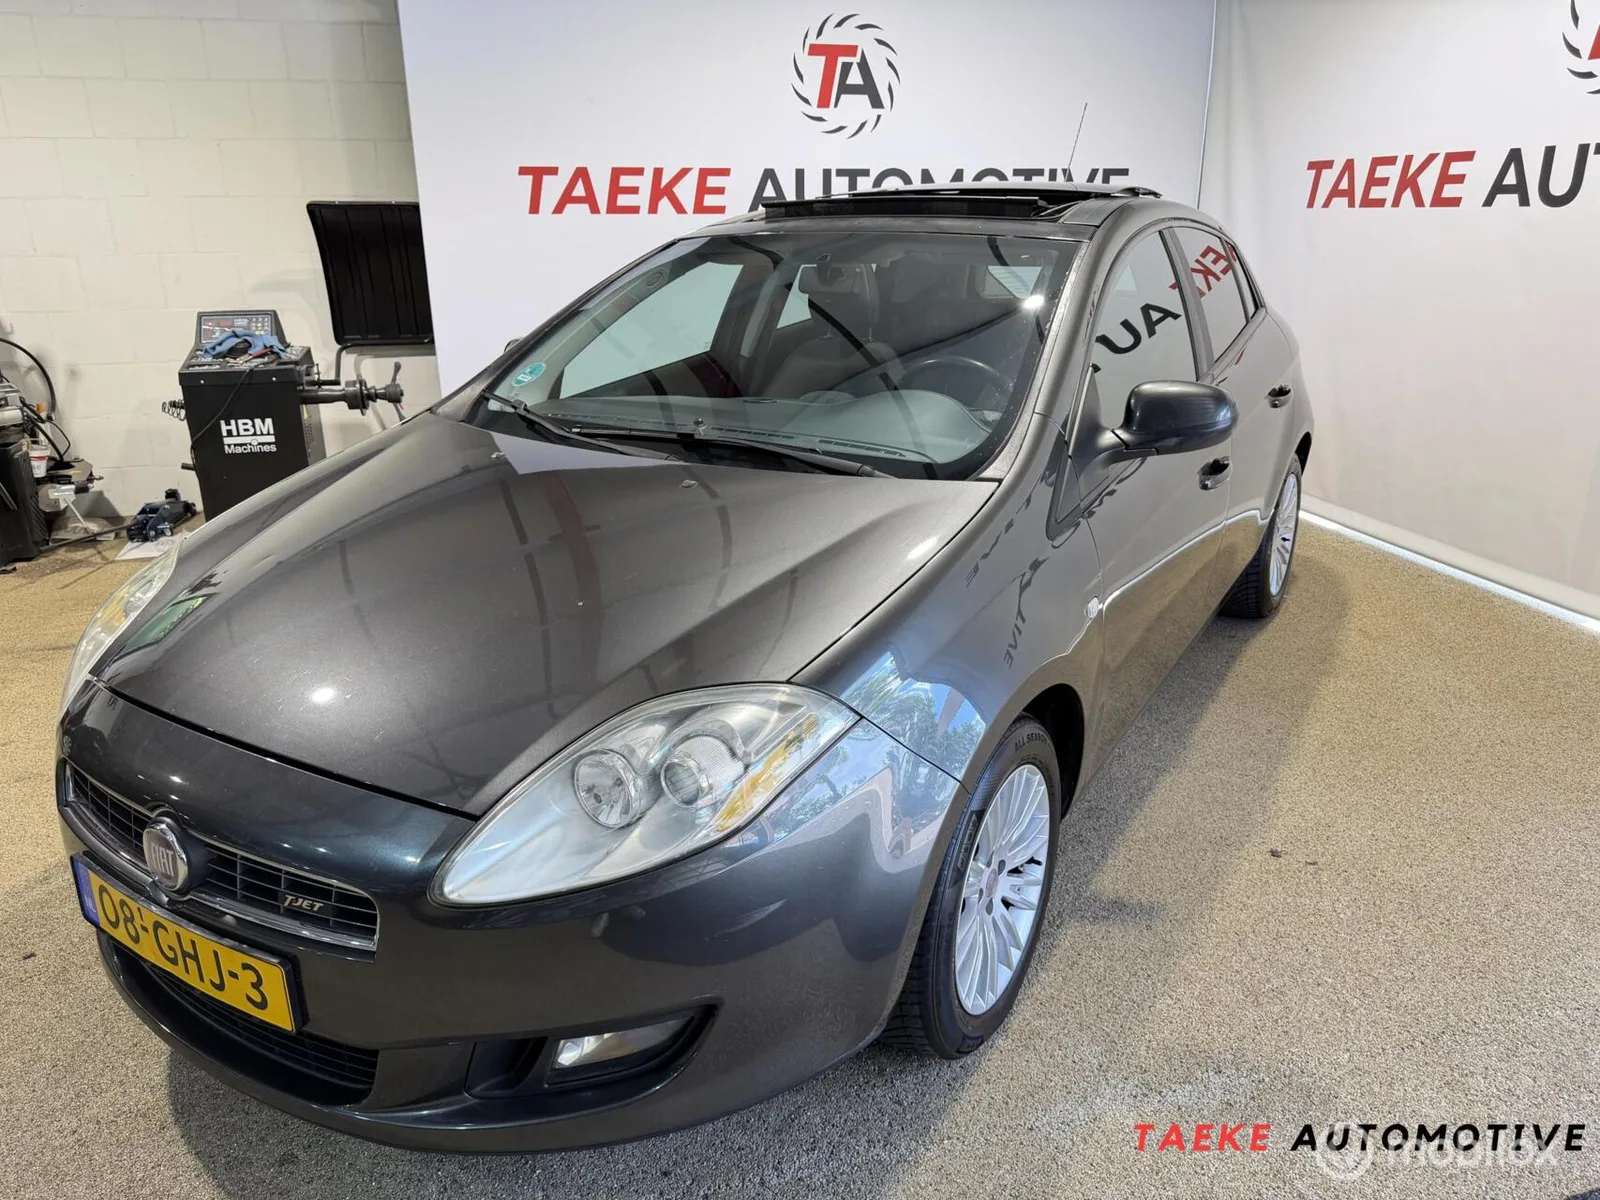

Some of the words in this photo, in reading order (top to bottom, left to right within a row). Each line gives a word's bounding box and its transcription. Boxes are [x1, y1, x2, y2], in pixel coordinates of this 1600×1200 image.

[808, 43, 885, 109] TA
[518, 165, 731, 215] TAEKE
[1306, 150, 1477, 209] TAEKE
[1481, 142, 1600, 208] AU
[220, 417, 275, 437] HBM
[224, 443, 278, 454] Machines
[149, 842, 175, 877] FIAT
[97, 884, 269, 1012] 08-GHJ-3
